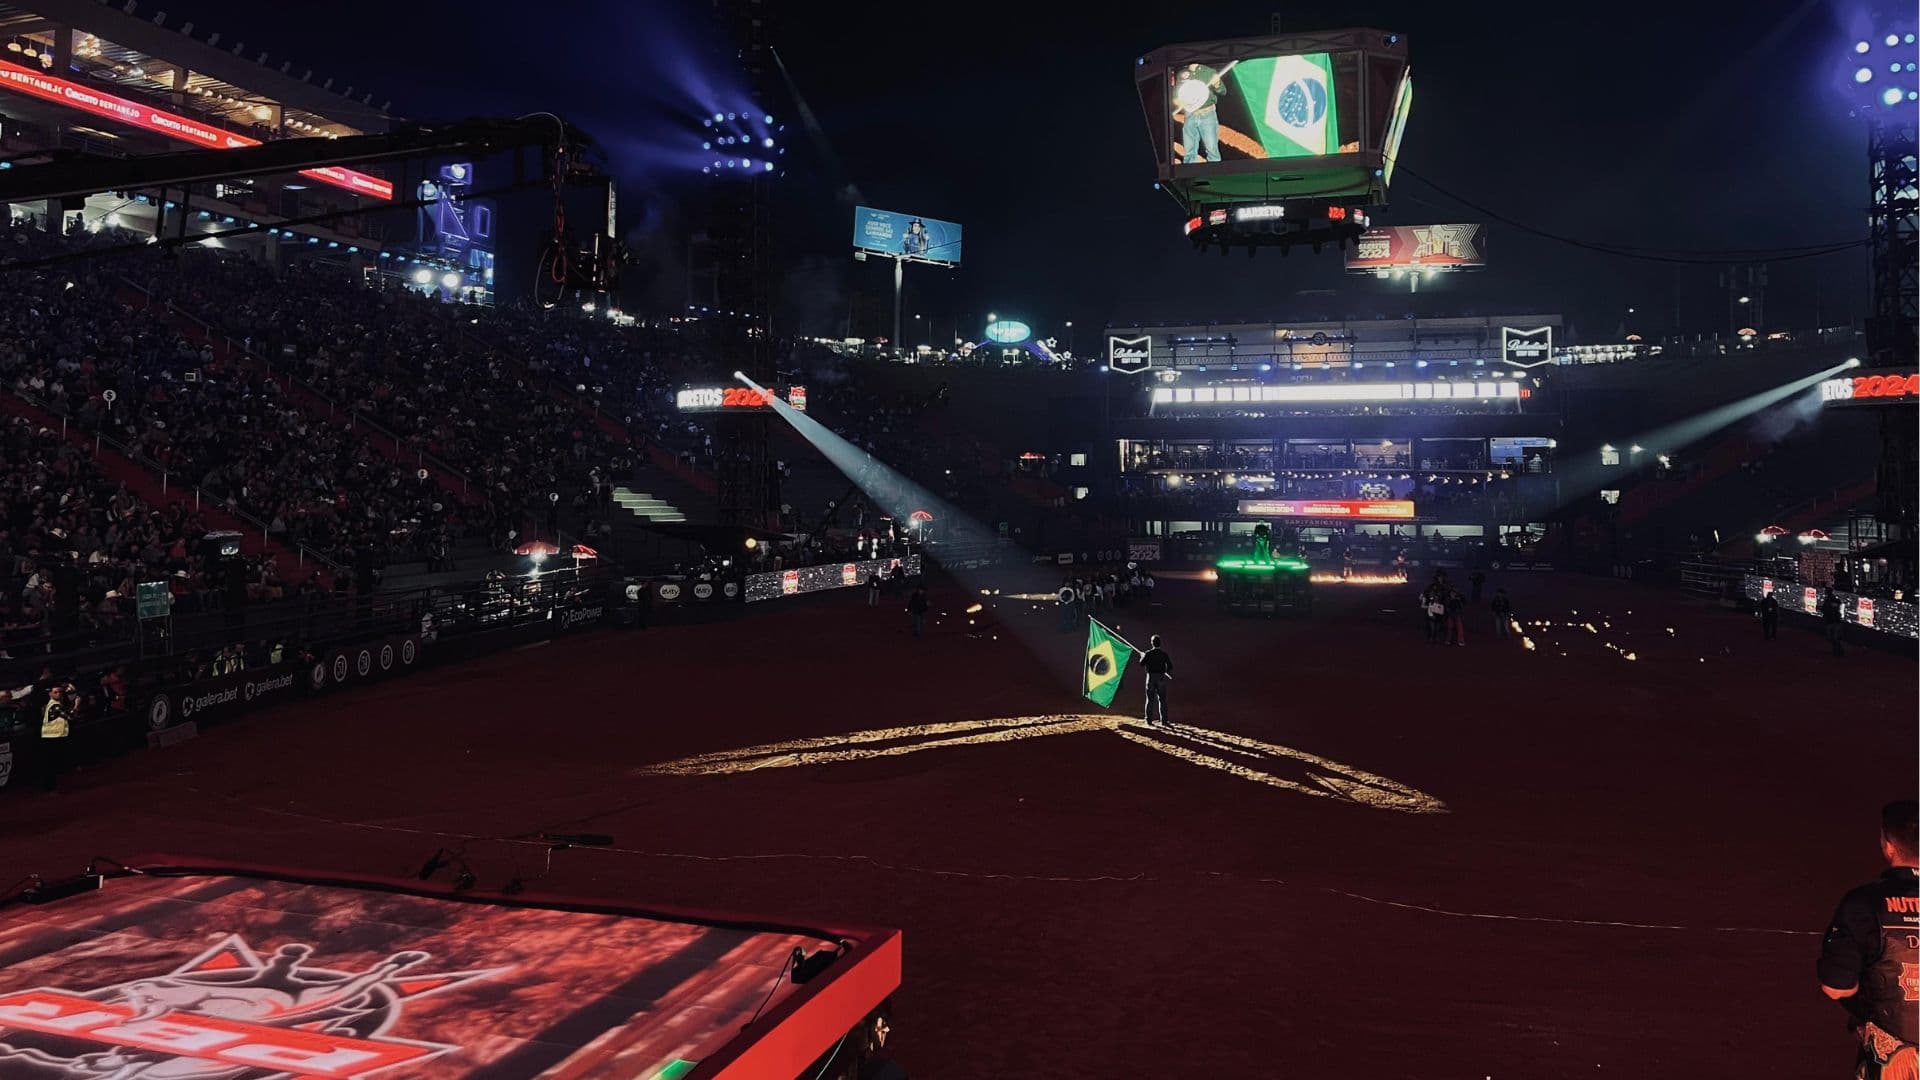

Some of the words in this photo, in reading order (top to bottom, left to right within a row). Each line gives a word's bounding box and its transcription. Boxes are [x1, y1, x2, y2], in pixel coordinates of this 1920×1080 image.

[722, 387, 775, 407] 2024
[1853, 374, 1919, 398] 2024
[1129, 550, 1160, 561] 2024
[570, 607, 603, 622] EcoPower
[256, 672, 293, 696] galera.bet
[195, 686, 238, 712] galera.bet
